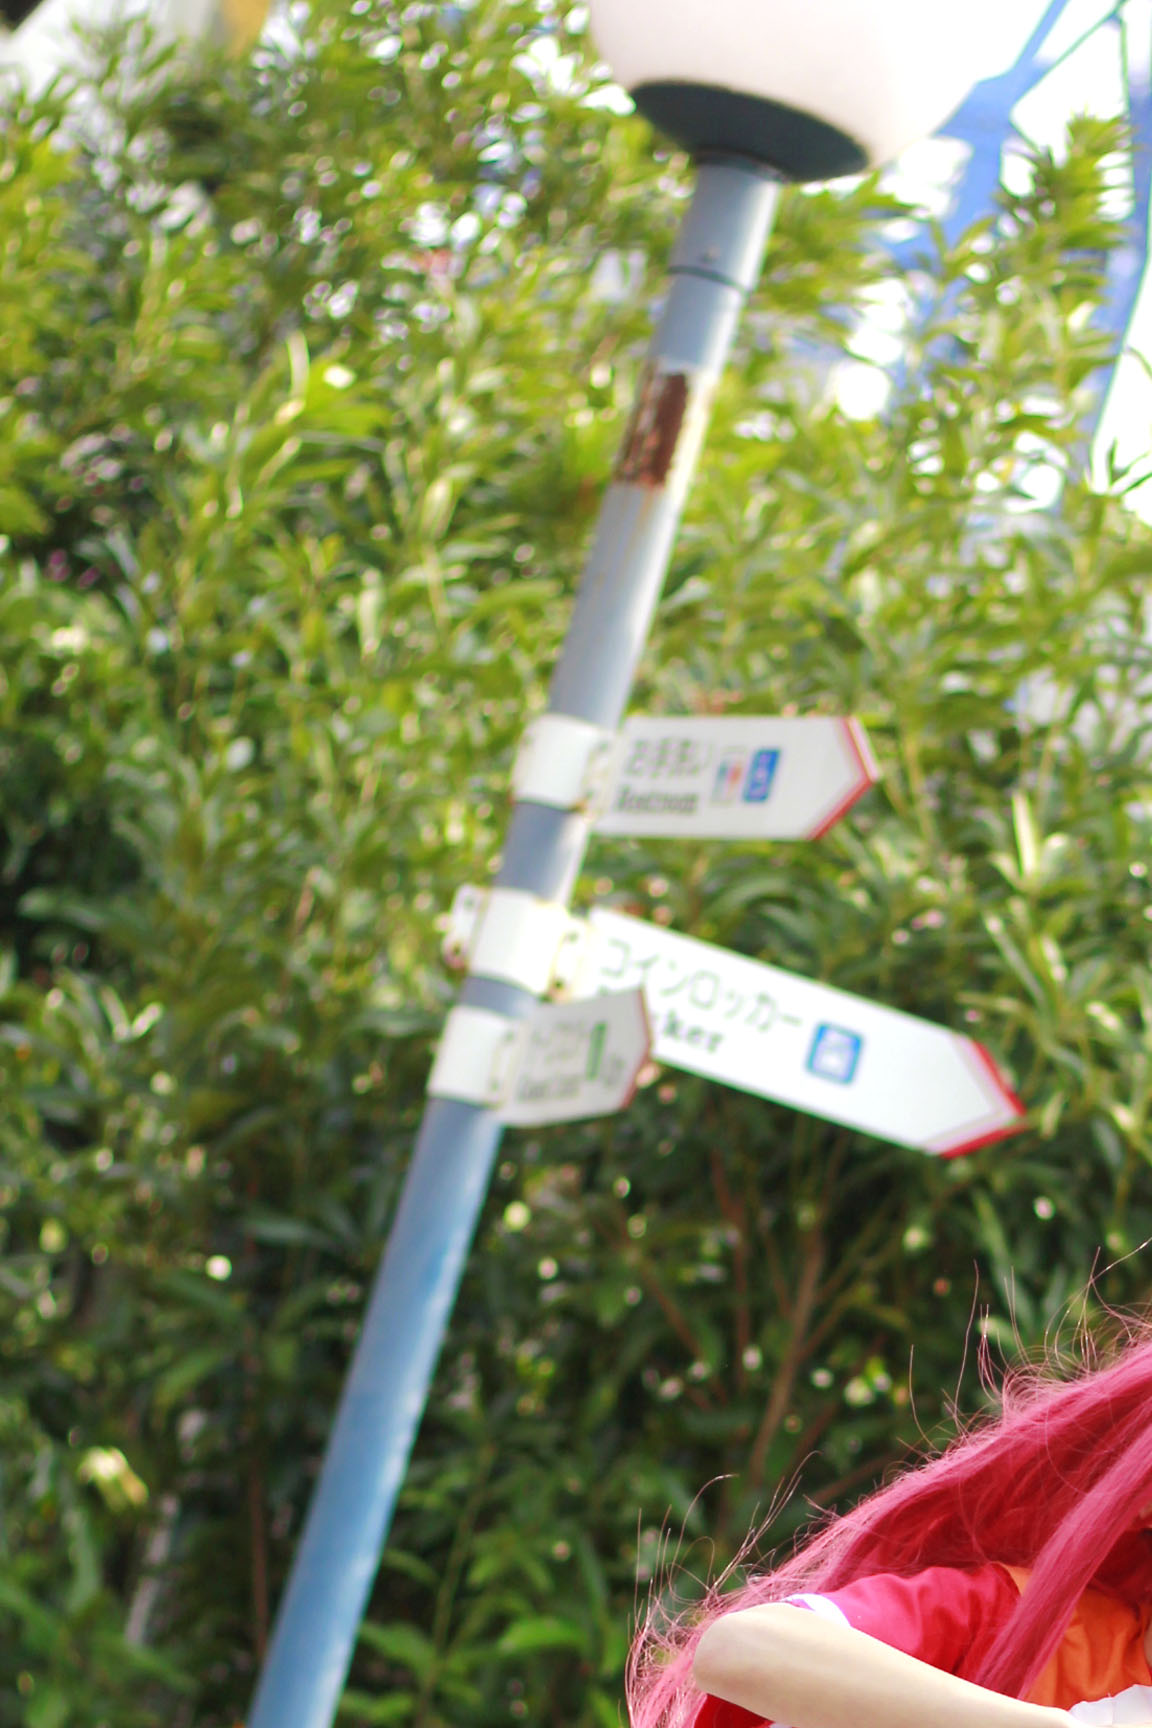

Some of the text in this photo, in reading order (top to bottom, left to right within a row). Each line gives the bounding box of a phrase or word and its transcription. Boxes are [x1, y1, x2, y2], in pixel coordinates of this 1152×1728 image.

[600, 938, 802, 1032] コインロッカー
